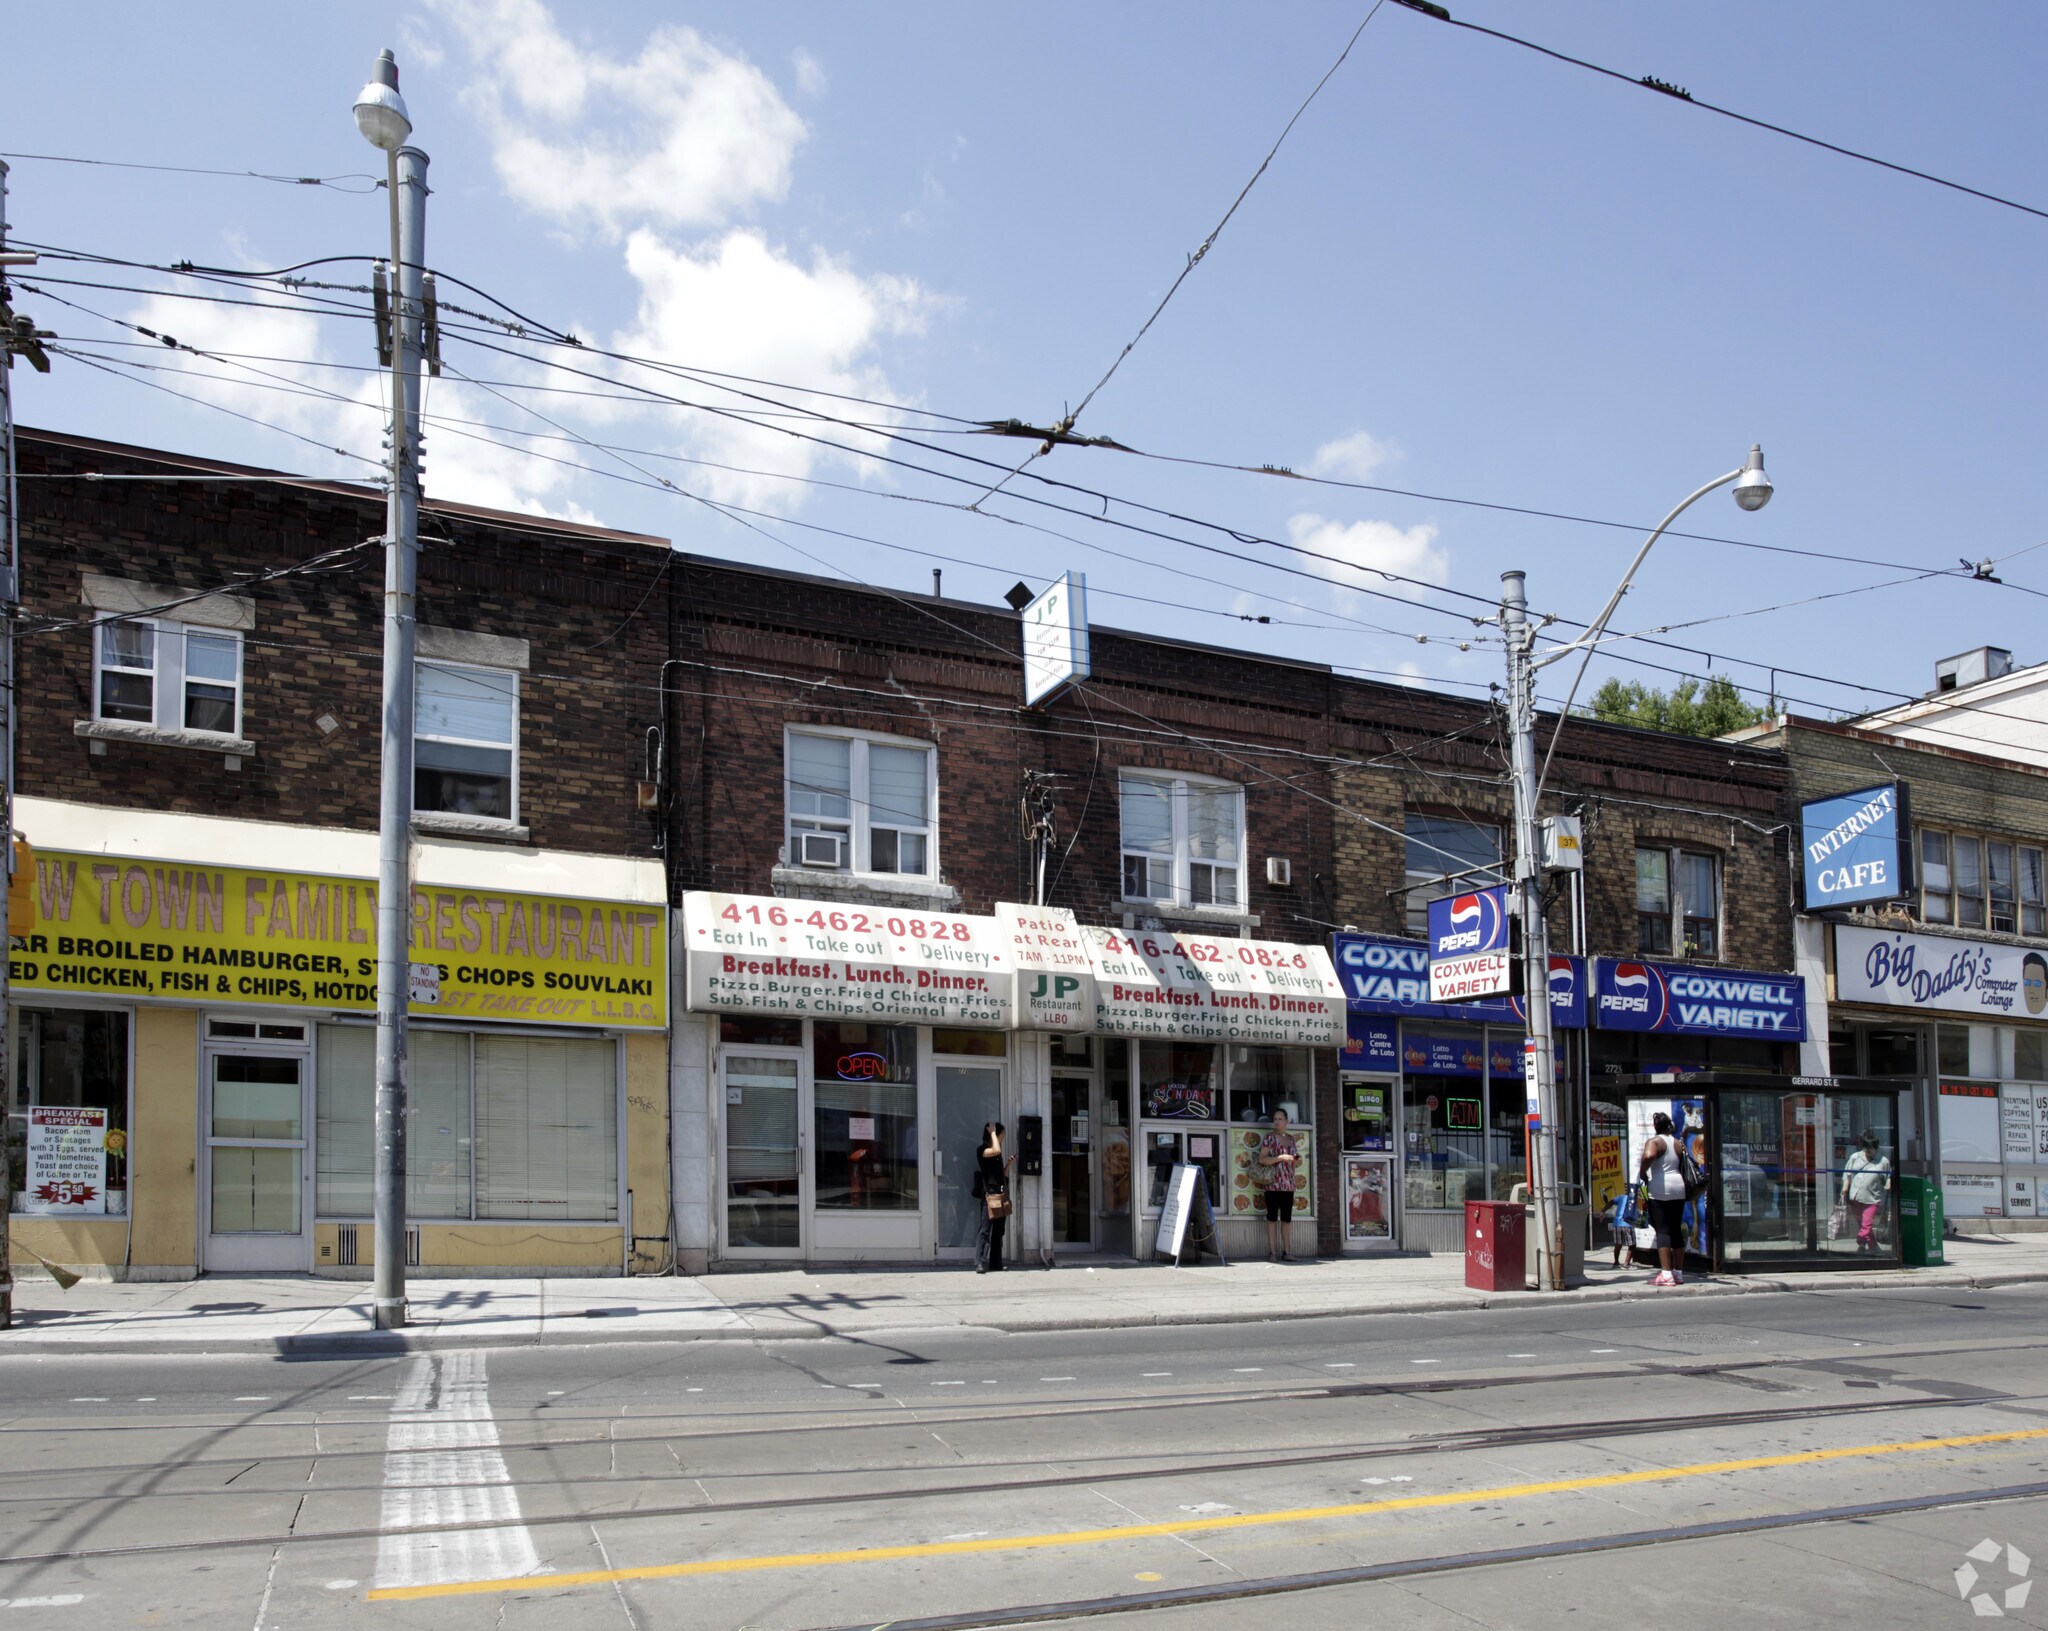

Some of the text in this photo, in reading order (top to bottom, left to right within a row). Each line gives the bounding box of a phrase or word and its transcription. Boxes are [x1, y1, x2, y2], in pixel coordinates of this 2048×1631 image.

[1035, 595, 1058, 625] JP
[1808, 790, 1894, 864] INTERNET
[1563, 838, 1573, 847] 37
[1818, 860, 1887, 893] CAFE
[91, 863, 224, 934] TOWN
[409, 890, 658, 967] RESTAURANT
[721, 903, 971, 942] 416-462-0828
[1016, 917, 1065, 933] Patio
[713, 928, 990, 968] Eat In Take out Delivery
[1014, 934, 1078, 949] at Rear
[1438, 929, 1481, 953] PEPSI
[58, 936, 174, 963] BROILED
[182, 946, 349, 978] HAMBURGER,
[457, 966, 535, 988] CHOPS
[544, 971, 653, 996] SOUVLAKI
[1017, 951, 1043, 963] 7AM
[1053, 953, 1085, 966] 11PM
[1343, 943, 1429, 972] COXW
[420, 966, 430, 977] NO
[722, 954, 989, 993] Breakfast. Lunch. Dinner.
[1433, 955, 1506, 980] COXWELL
[1865, 935, 1992, 1003] Big Daddy's
[46, 964, 154, 992] CHICKEN,
[161, 972, 209, 992] FISH
[216, 975, 231, 994] &
[238, 976, 307, 1000] CHIPS,
[314, 981, 379, 1003] HOTDO
[410, 976, 439, 990] STANDING
[1101, 960, 1324, 994] Eat In Take out Delivery
[1975, 975, 2018, 995] Computer
[1029, 974, 1080, 999] JP
[1351, 973, 1430, 1001] VARI
[1438, 975, 1501, 998] VARIETY
[1669, 975, 1795, 1006] COXWELL
[478, 992, 584, 1015] TAKE-OUT
[1030, 998, 1082, 1012] Restaurant
[1113, 984, 1329, 1014] Breakfast. Lunch. Dinner.
[1600, 994, 1648, 1013] PEPSI
[1980, 991, 2014, 1012] Lounge
[795, 998, 808, 1009] &
[960, 1008, 1001, 1021] Food
[1044, 1012, 1068, 1025] LLBO
[1677, 1002, 1790, 1032] VARIETY
[1166, 1023, 1177, 1034] &
[1181, 1024, 1222, 1038] Chips
[1228, 1026, 1288, 1041] Oriental
[1297, 1031, 1331, 1042] Food
[1369, 1031, 1388, 1040] Lotto
[1369, 1039, 1392, 1049] Centre
[1369, 1048, 1395, 1057] de Loto
[1433, 1044, 1450, 1053] Lotto
[1433, 1052, 1454, 1061] Centre
[1433, 1060, 1457, 1070] de Loto
[837, 1056, 885, 1077] OPEN
[1791, 1077, 1840, 1087] GERRARD ST. E.
[1359, 1095, 1380, 1104] BINGO
[35, 1109, 104, 1119] BREAKFAST
[45, 1117, 92, 1126] SPECIAL
[1450, 1102, 1479, 1125] ATM
[2004, 1109, 2030, 1118] COPYING
[2004, 1122, 2032, 1130] COMPUTER
[54, 1136, 92, 1145] Sausages
[2008, 1131, 2028, 1140] REPAIR
[30, 1144, 47, 1152] with
[80, 1146, 105, 1154] served
[1762, 1144, 1777, 1152] MAIL
[2005, 1143, 2032, 1154] INTERNET
[35, 1161, 100, 1170] Toast and choice
[1592, 1154, 1618, 1172] ATM
[36, 1170, 44, 1178] of
[47, 1171, 71, 1179] Coffee
[83, 1171, 97, 1179] Tea
[2015, 1182, 2026, 1192] FAX
[2010, 1197, 2032, 1208] SERVICE
[1929, 1201, 1938, 1247] metro
